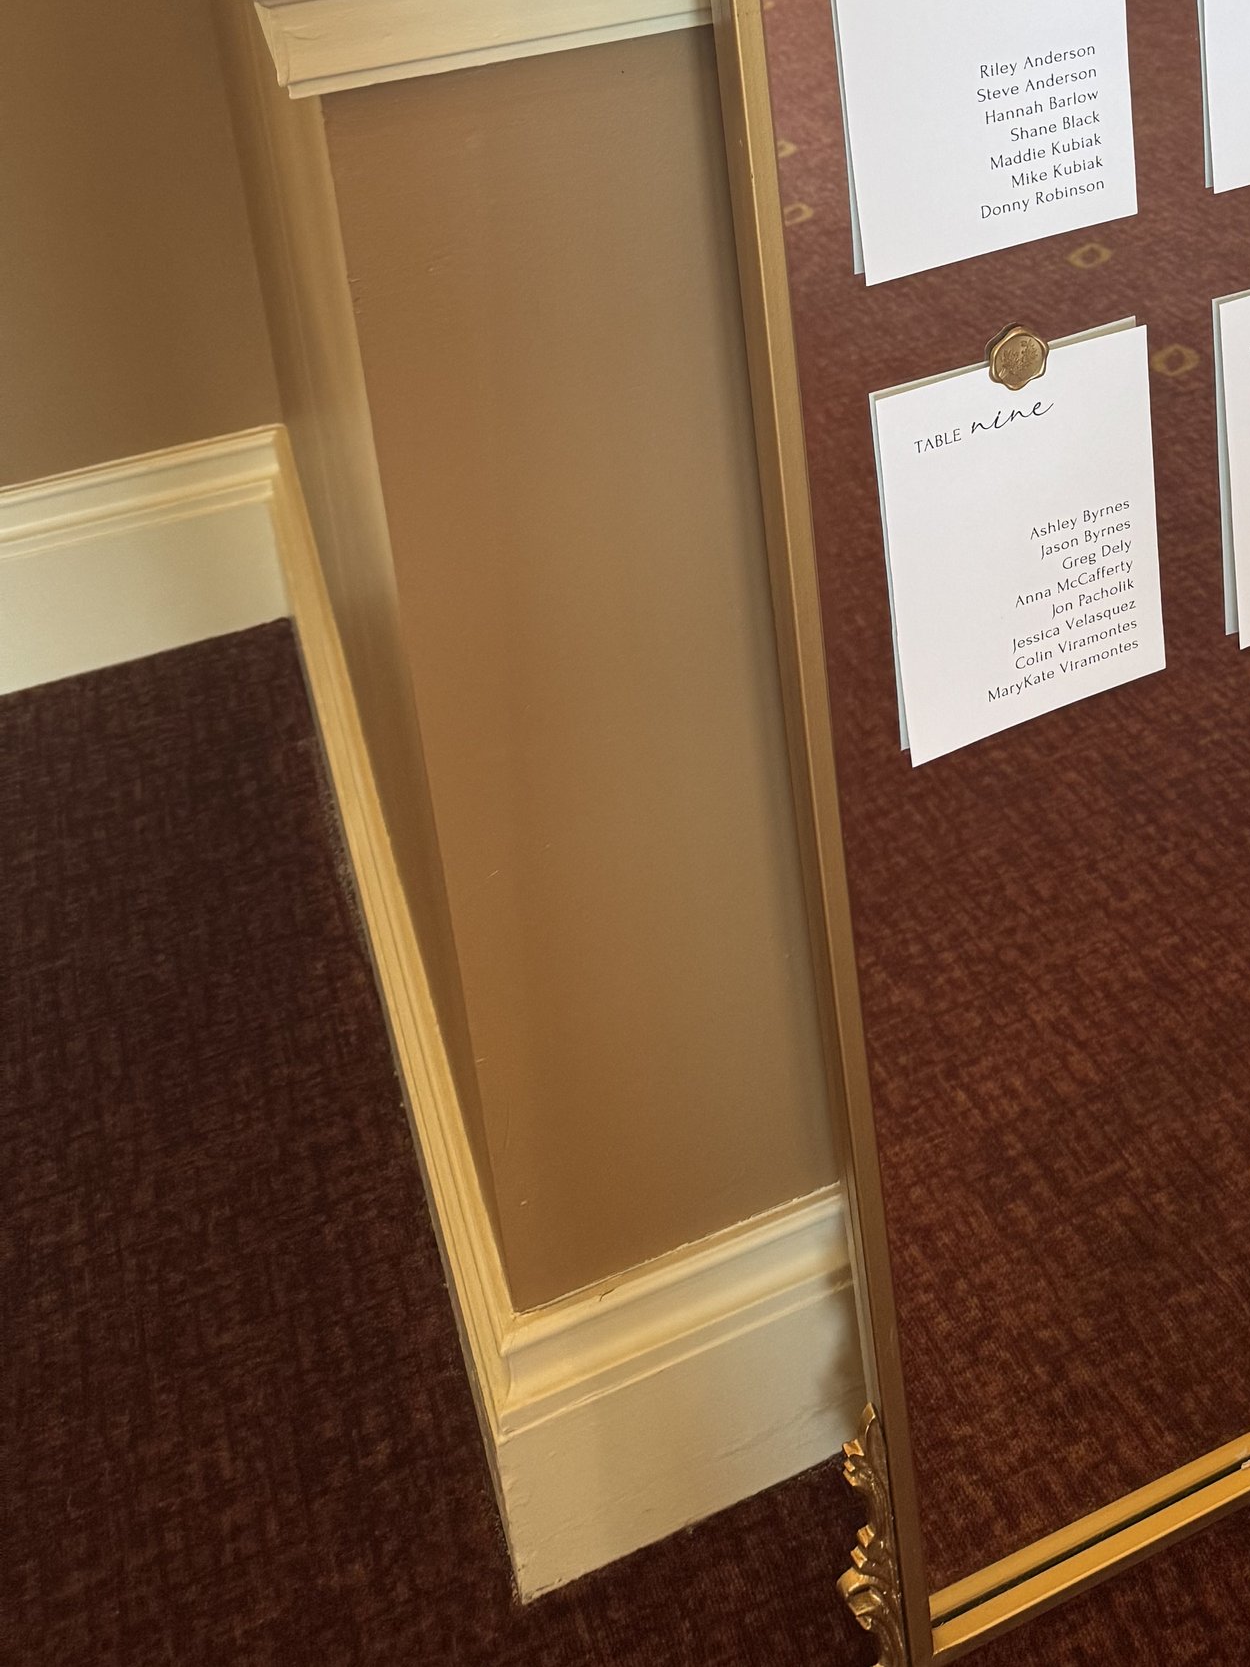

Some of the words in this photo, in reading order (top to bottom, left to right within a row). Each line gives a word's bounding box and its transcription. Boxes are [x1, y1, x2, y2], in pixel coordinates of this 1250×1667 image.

[980, 63, 1017, 78] Riley
[1024, 46, 1095, 69] Anderson
[986, 101, 1043, 124] Hannah
[1049, 91, 1098, 110] Barlow
[1011, 124, 1056, 141] Shane
[1063, 111, 1100, 130] Black
[991, 148, 1045, 170] Maddie
[1052, 133, 1102, 155] Kubiak
[981, 199, 1029, 219] Donny
[1036, 181, 1104, 205] Robinson
[914, 428, 961, 453] TABLE
[971, 402, 1054, 434] nine
[1031, 518, 1077, 540] Ashley
[1083, 501, 1129, 523] Byrnes
[1062, 553, 1096, 569] Greg
[1102, 540, 1131, 557] Dely
[1016, 589, 1051, 608] Anna
[1057, 560, 1133, 593] McCafferty
[1052, 602, 1072, 620] Jon
[1079, 578, 1134, 606] Pacholik
[1013, 627, 1059, 654] Jessica
[1065, 600, 1136, 630] Velasquez
[1016, 651, 1052, 669] Colin
[1058, 621, 1137, 653] Viramontes
